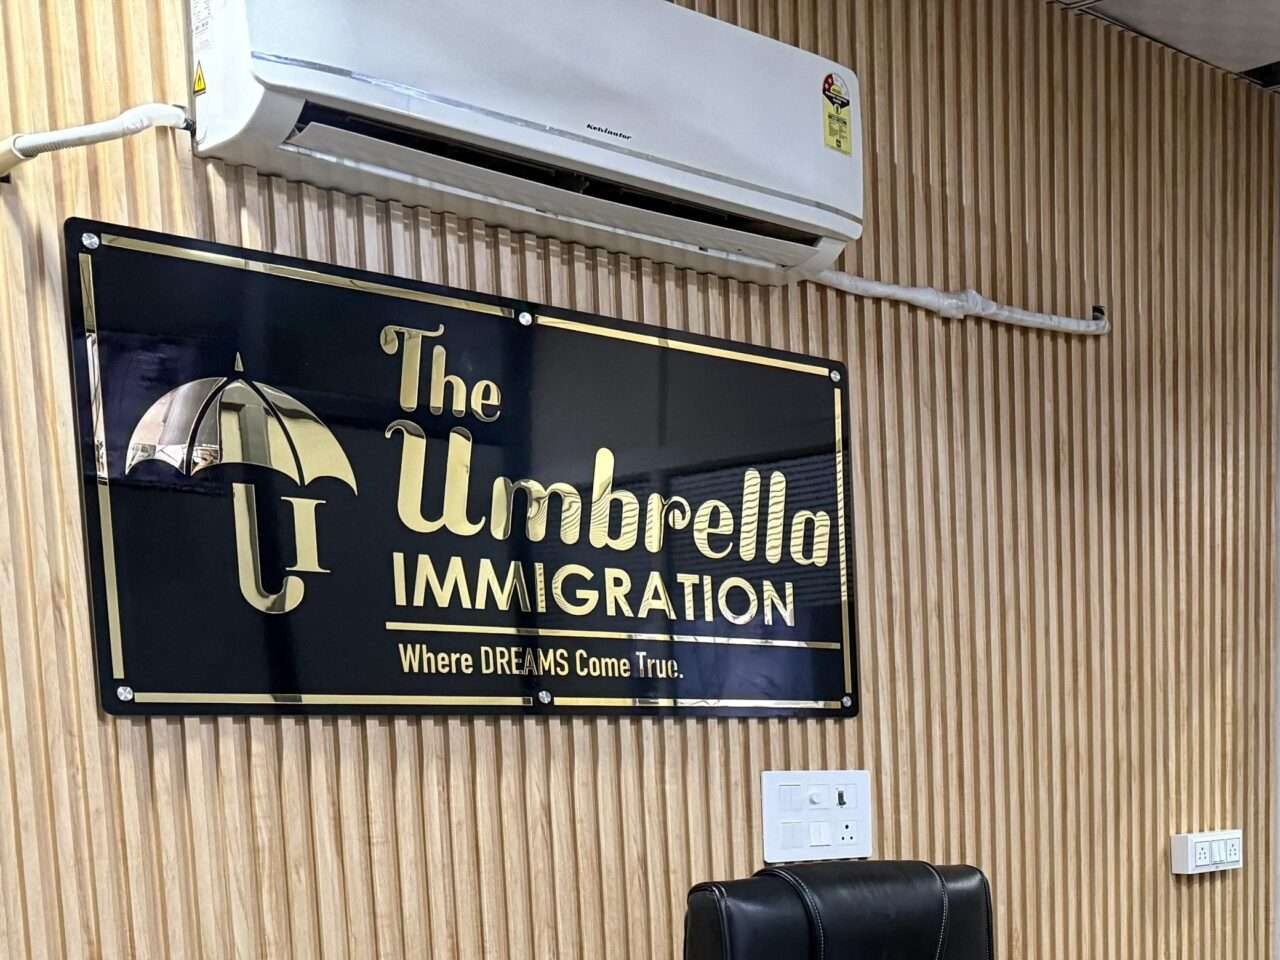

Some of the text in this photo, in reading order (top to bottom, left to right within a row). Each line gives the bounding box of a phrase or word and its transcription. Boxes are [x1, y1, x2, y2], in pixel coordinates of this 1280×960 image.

[380, 324, 501, 422] The
[385, 419, 831, 567] Umbrella
[393, 552, 795, 627] IMMIGRATION
[398, 643, 473, 674] Where
[480, 646, 569, 676] DREAMS
[575, 649, 631, 677] Come
